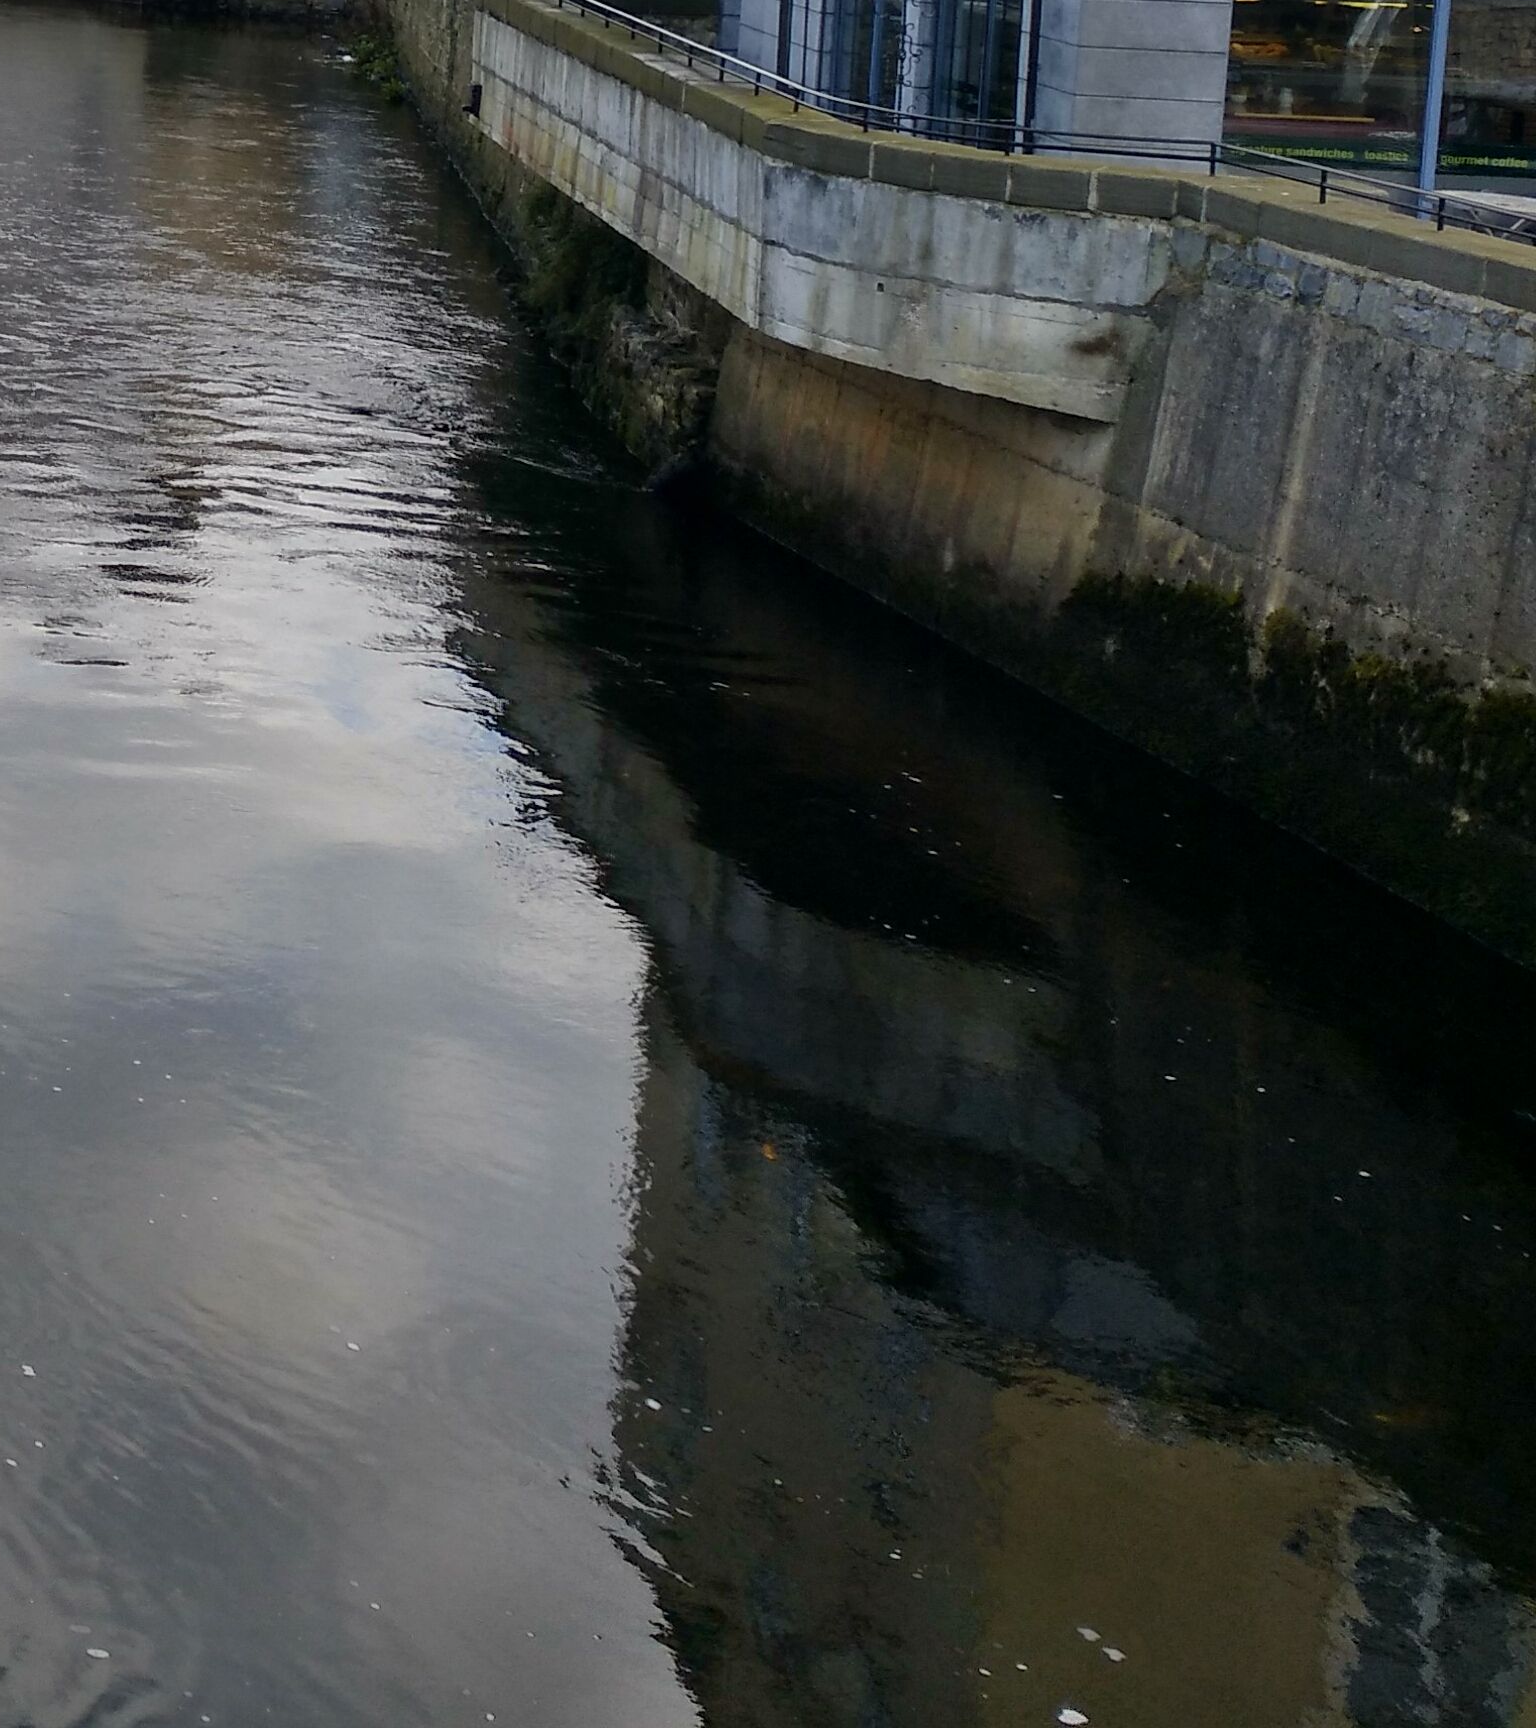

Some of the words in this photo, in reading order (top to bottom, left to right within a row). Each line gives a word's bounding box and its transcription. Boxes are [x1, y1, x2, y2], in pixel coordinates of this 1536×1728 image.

[1285, 146, 1355, 159] sandwiches
[1440, 154, 1489, 167] gourmet
[1490, 156, 1529, 169] coffee
